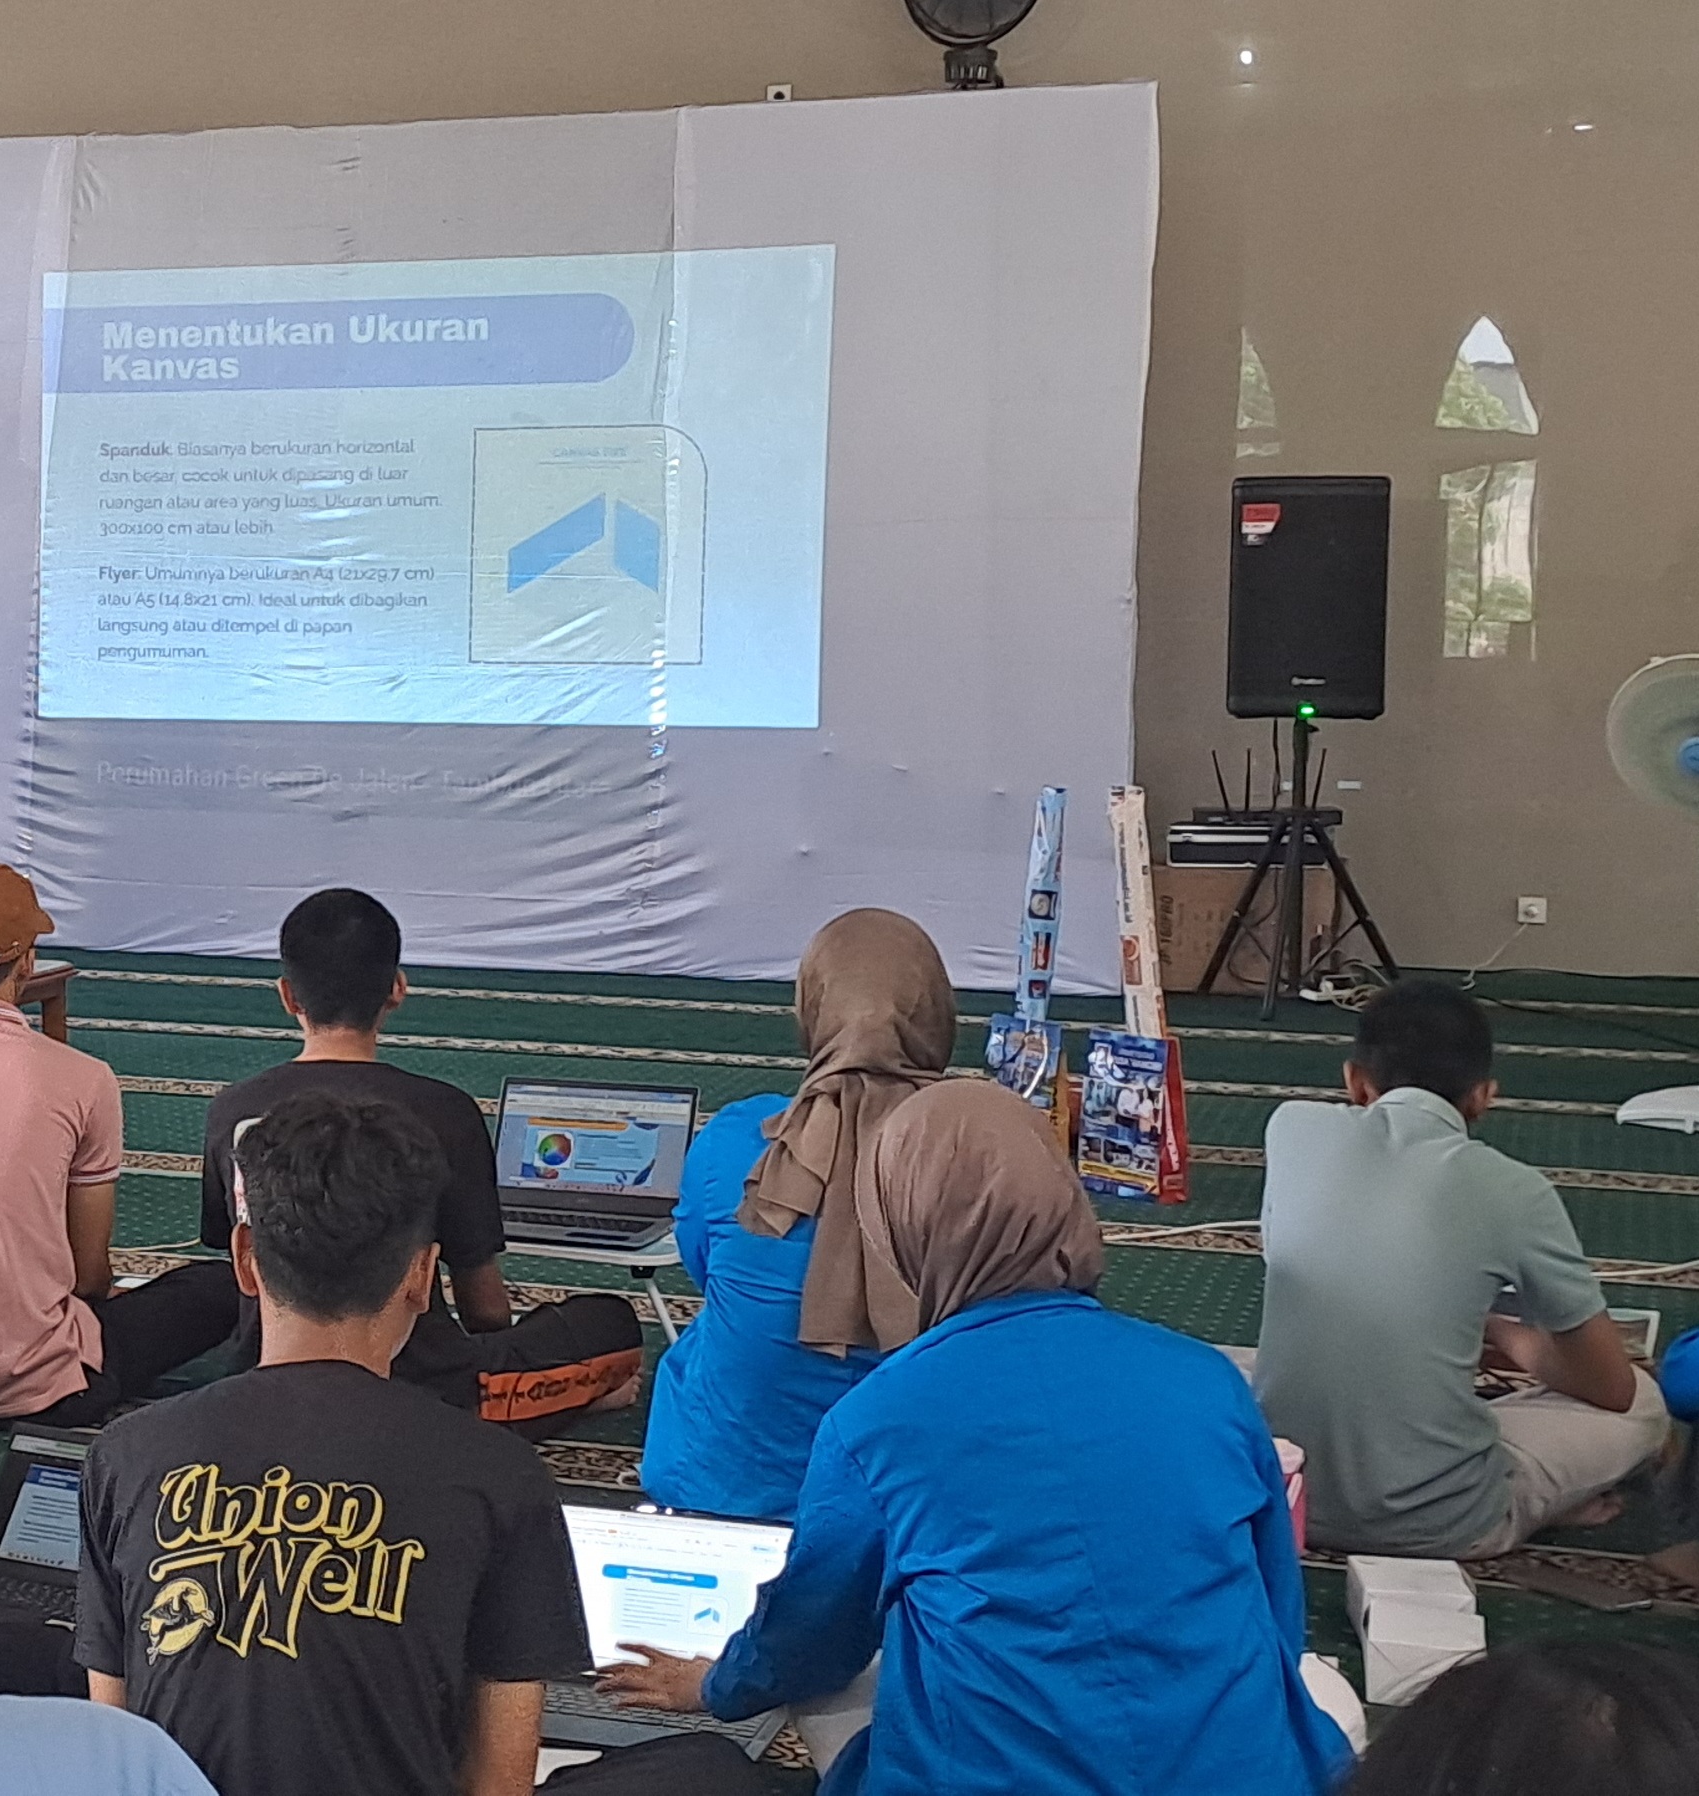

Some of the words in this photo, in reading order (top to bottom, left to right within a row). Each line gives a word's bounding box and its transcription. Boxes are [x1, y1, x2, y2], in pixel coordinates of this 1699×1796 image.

[102, 317, 334, 349] Menentukan
[349, 314, 489, 343] Ukuran
[102, 354, 240, 382] Kanvas
[250, 439, 331, 456] berukuran
[336, 438, 414, 454] horizontal
[99, 469, 129, 483] dan
[233, 468, 277, 482] untuk
[359, 466, 373, 481] di
[378, 466, 408, 481] luar
[166, 495, 200, 509] atau
[204, 497, 238, 509] area
[240, 496, 280, 512] yang
[168, 523, 193, 535] cm
[195, 520, 230, 535] atau
[313, 566, 334, 581] A4
[98, 592, 131, 606] atau
[349, 592, 428, 611] dibagikan
[98, 617, 168, 635] langsung
[173, 618, 206, 633] atau
[211, 618, 280, 635] ditempel
[284, 618, 298, 633] di
[303, 621, 353, 637] papan
[155, 1463, 384, 1549] Union
[149, 1537, 425, 1660] Well
